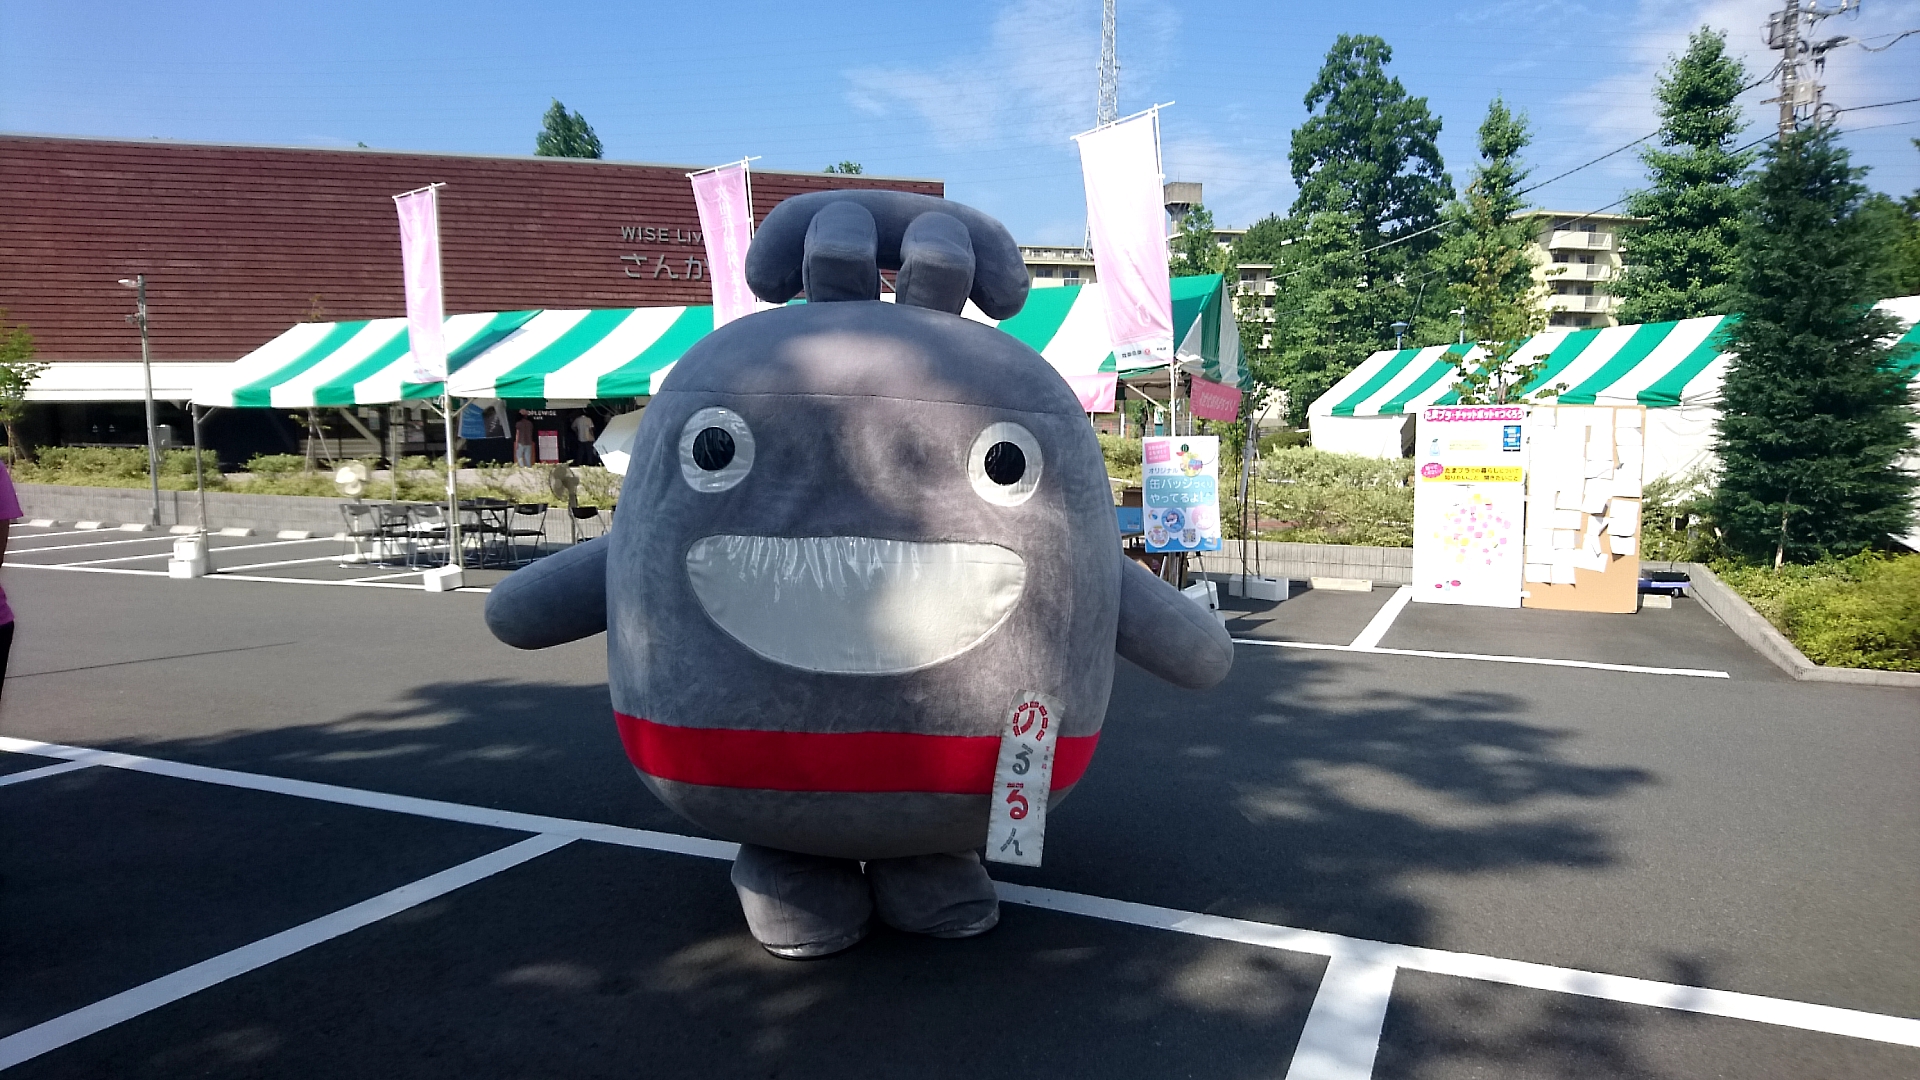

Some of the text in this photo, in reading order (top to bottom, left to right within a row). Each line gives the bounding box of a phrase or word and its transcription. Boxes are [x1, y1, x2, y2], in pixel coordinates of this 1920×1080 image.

[621, 226, 669, 242] WISE
[620, 253, 710, 280] さんか
[1000, 701, 1048, 856] のるるん
